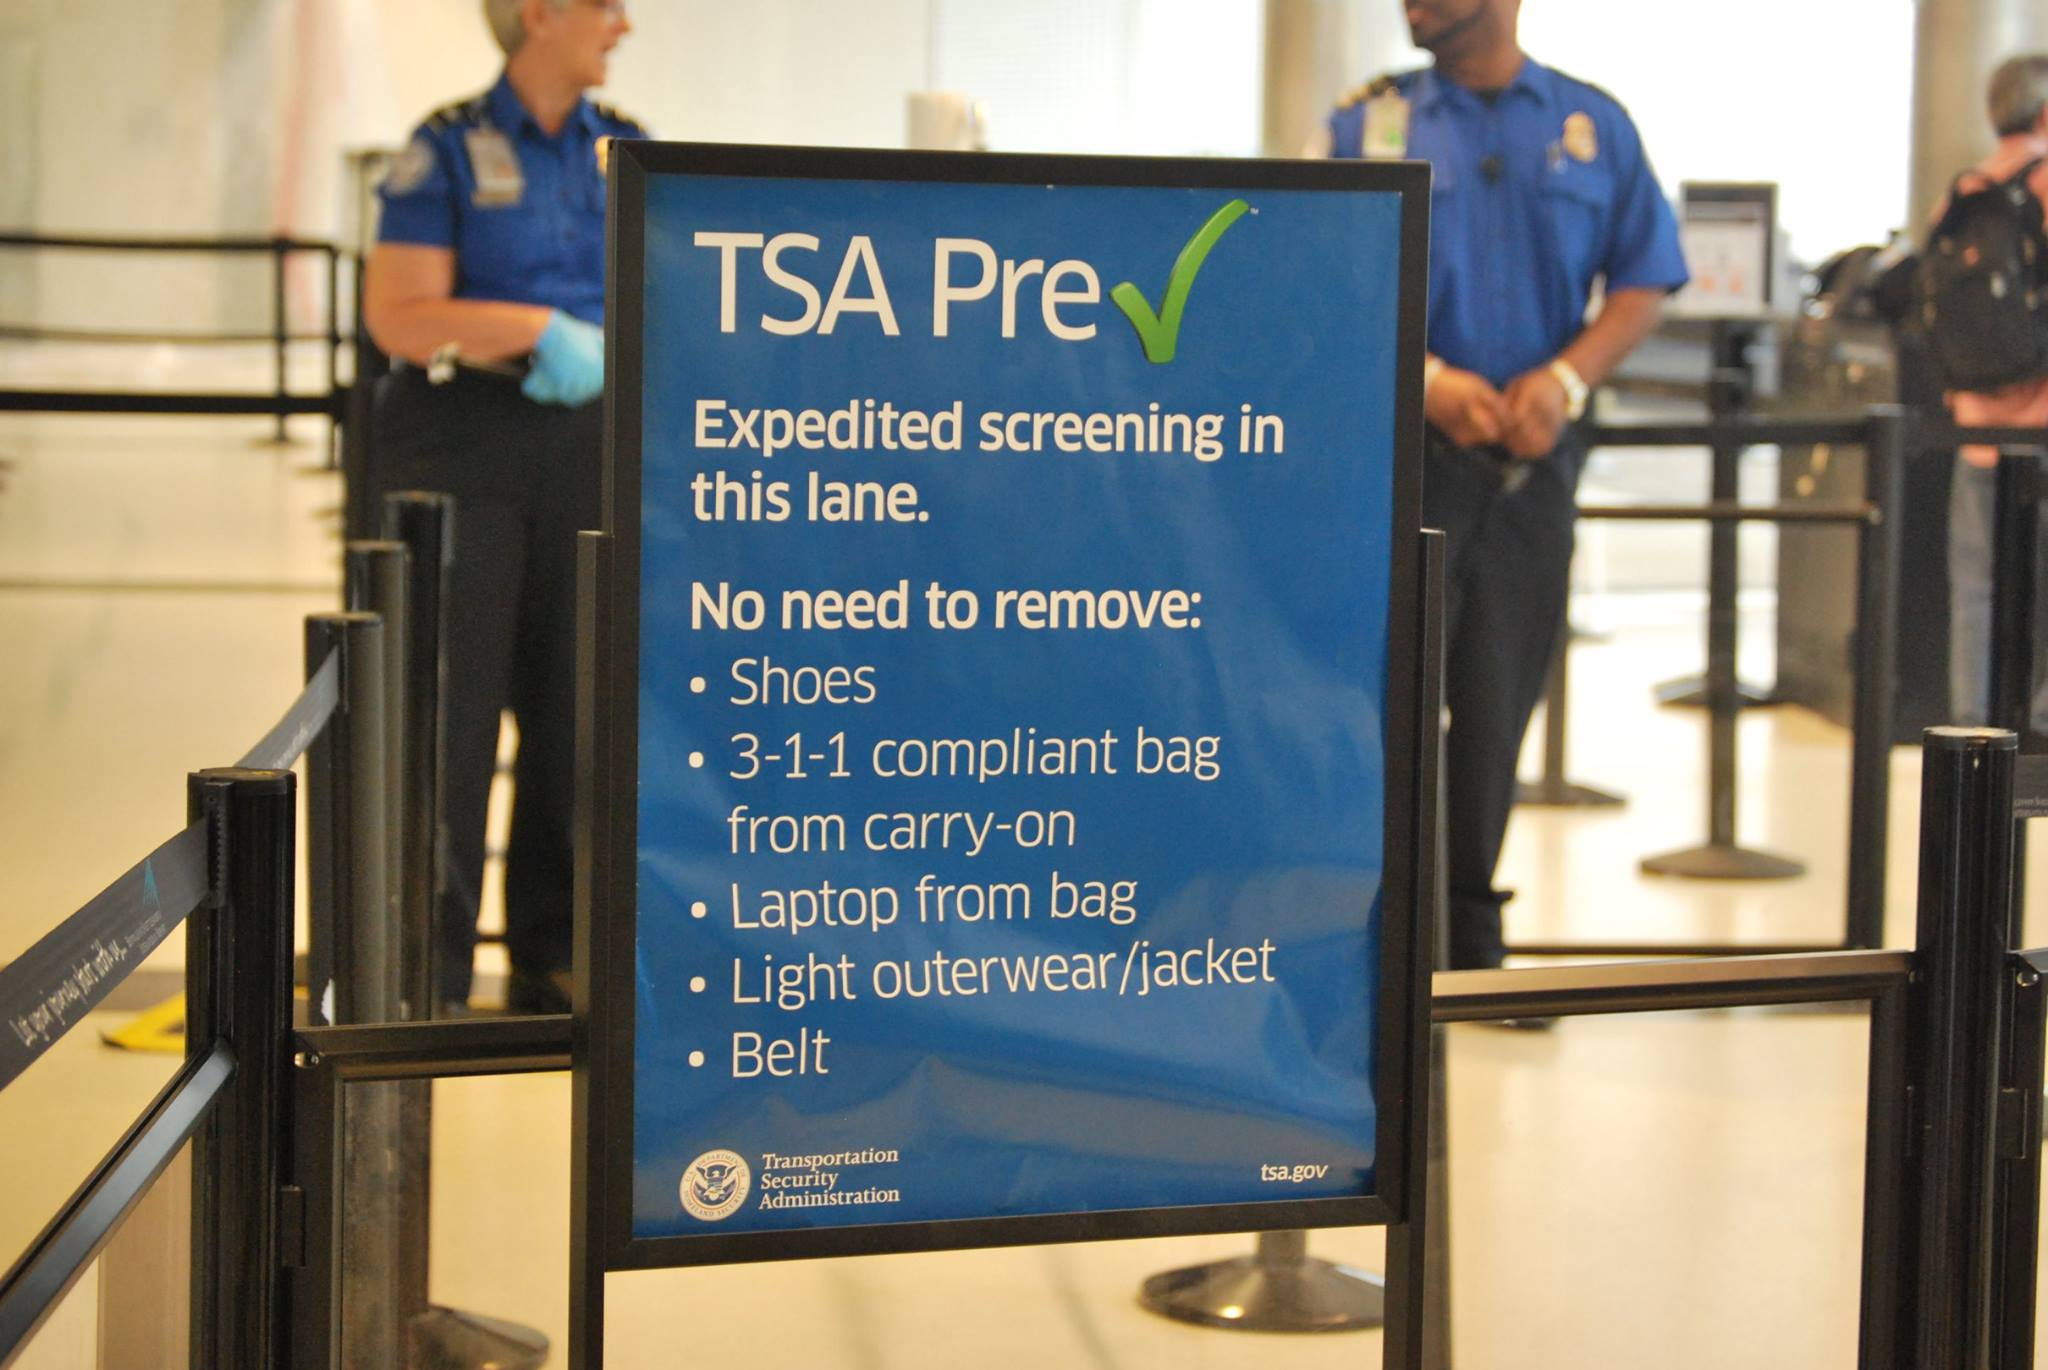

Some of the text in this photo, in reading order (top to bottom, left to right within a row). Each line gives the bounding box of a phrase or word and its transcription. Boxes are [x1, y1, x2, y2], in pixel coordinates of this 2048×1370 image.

[693, 231, 901, 336] TSA
[933, 237, 1101, 341] Pre
[694, 398, 1284, 463] Expedited screening in
[690, 470, 929, 522] this lane.
[691, 579, 1202, 631] No need to remove:
[730, 655, 876, 705] Shoes
[729, 726, 1221, 784] 3-1-1 compliant bag
[726, 805, 1075, 857] from carry-on
[731, 871, 1138, 936] Laptop from bag
[733, 937, 1277, 1011] Light outerwear/jacket
[732, 1027, 831, 1078] Belt
[760, 1171, 839, 1191] Security
[761, 1147, 900, 1170] Transportation
[1260, 1163, 1329, 1183] tsa.gov
[758, 1186, 900, 1210] Administration
